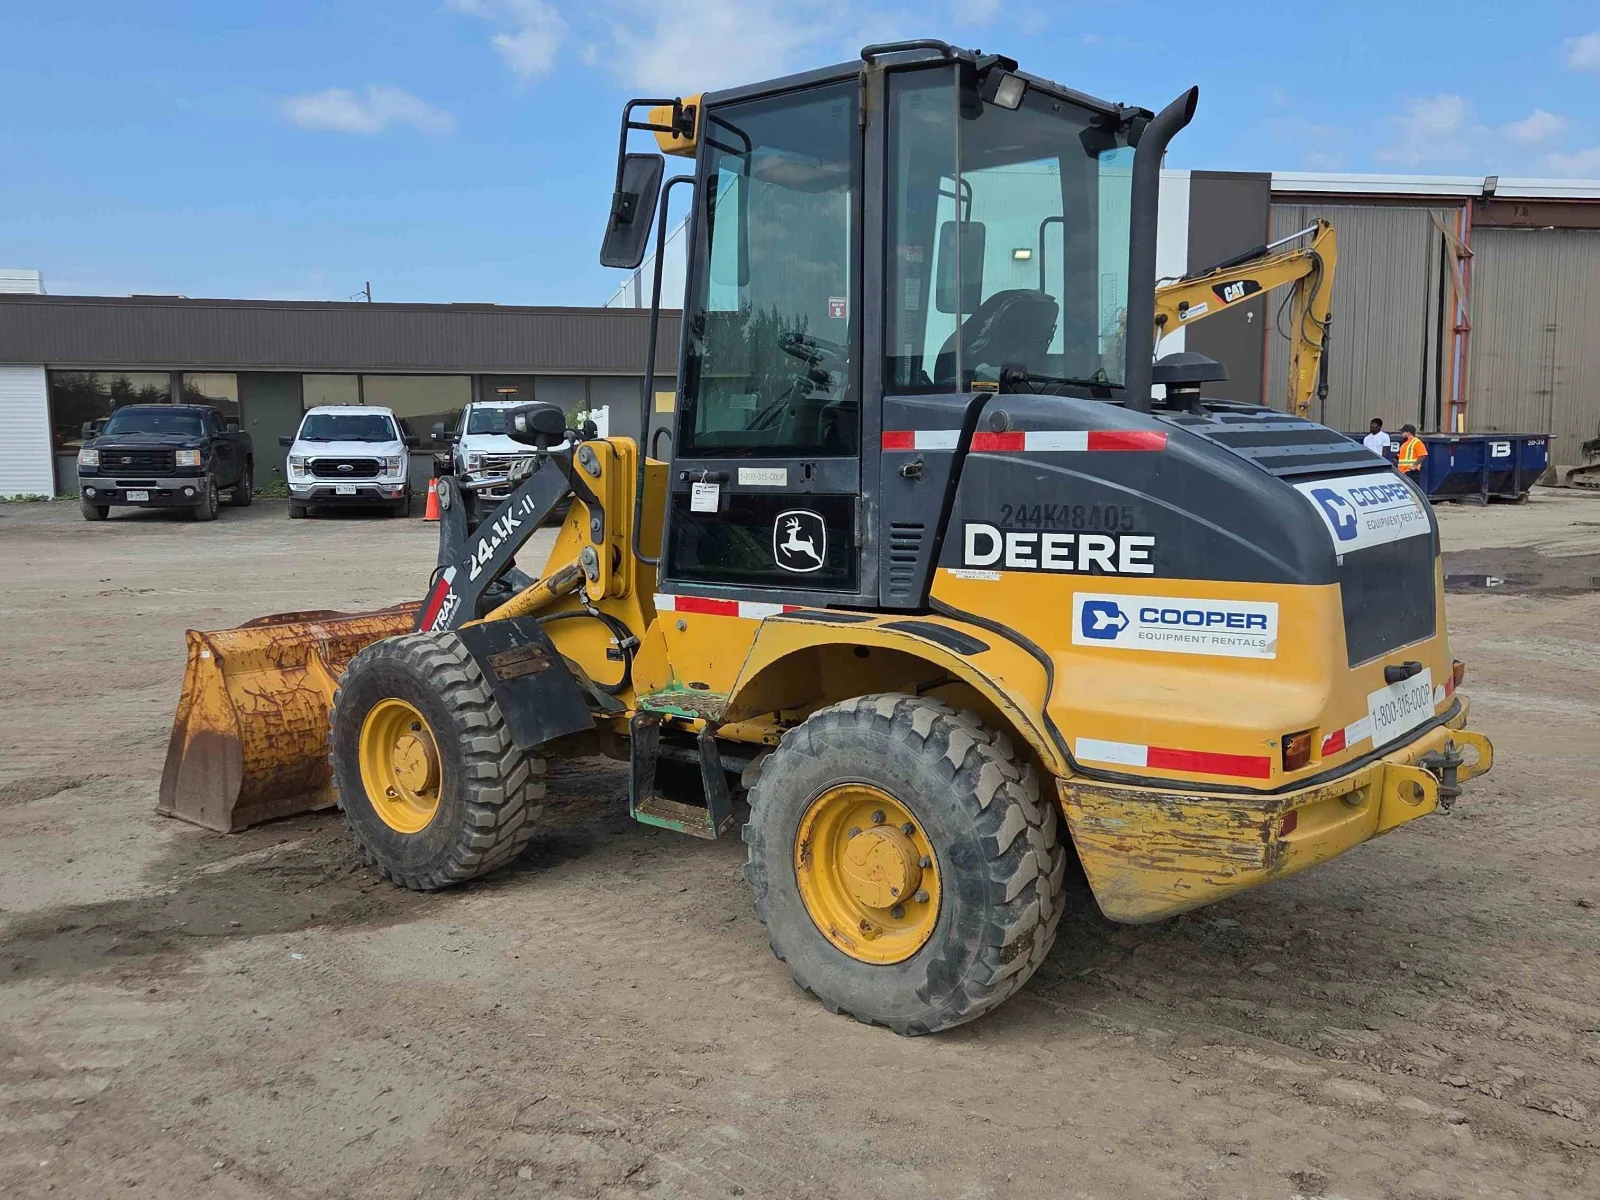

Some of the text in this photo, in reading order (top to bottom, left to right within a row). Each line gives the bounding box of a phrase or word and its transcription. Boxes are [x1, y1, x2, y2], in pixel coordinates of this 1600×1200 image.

[1224, 281, 1245, 302] CAT
[1348, 483, 1412, 507] COOPER
[1000, 504, 1135, 530] 244K48405
[1367, 510, 1424, 530] EQUIPMENT RENTALS
[964, 523, 1156, 574] DEERE
[1139, 607, 1267, 630] COOPER
[1138, 632, 1267, 648] EQUIPMENT RENTALS
[1372, 683, 1430, 731] 1-800-315-COOP
